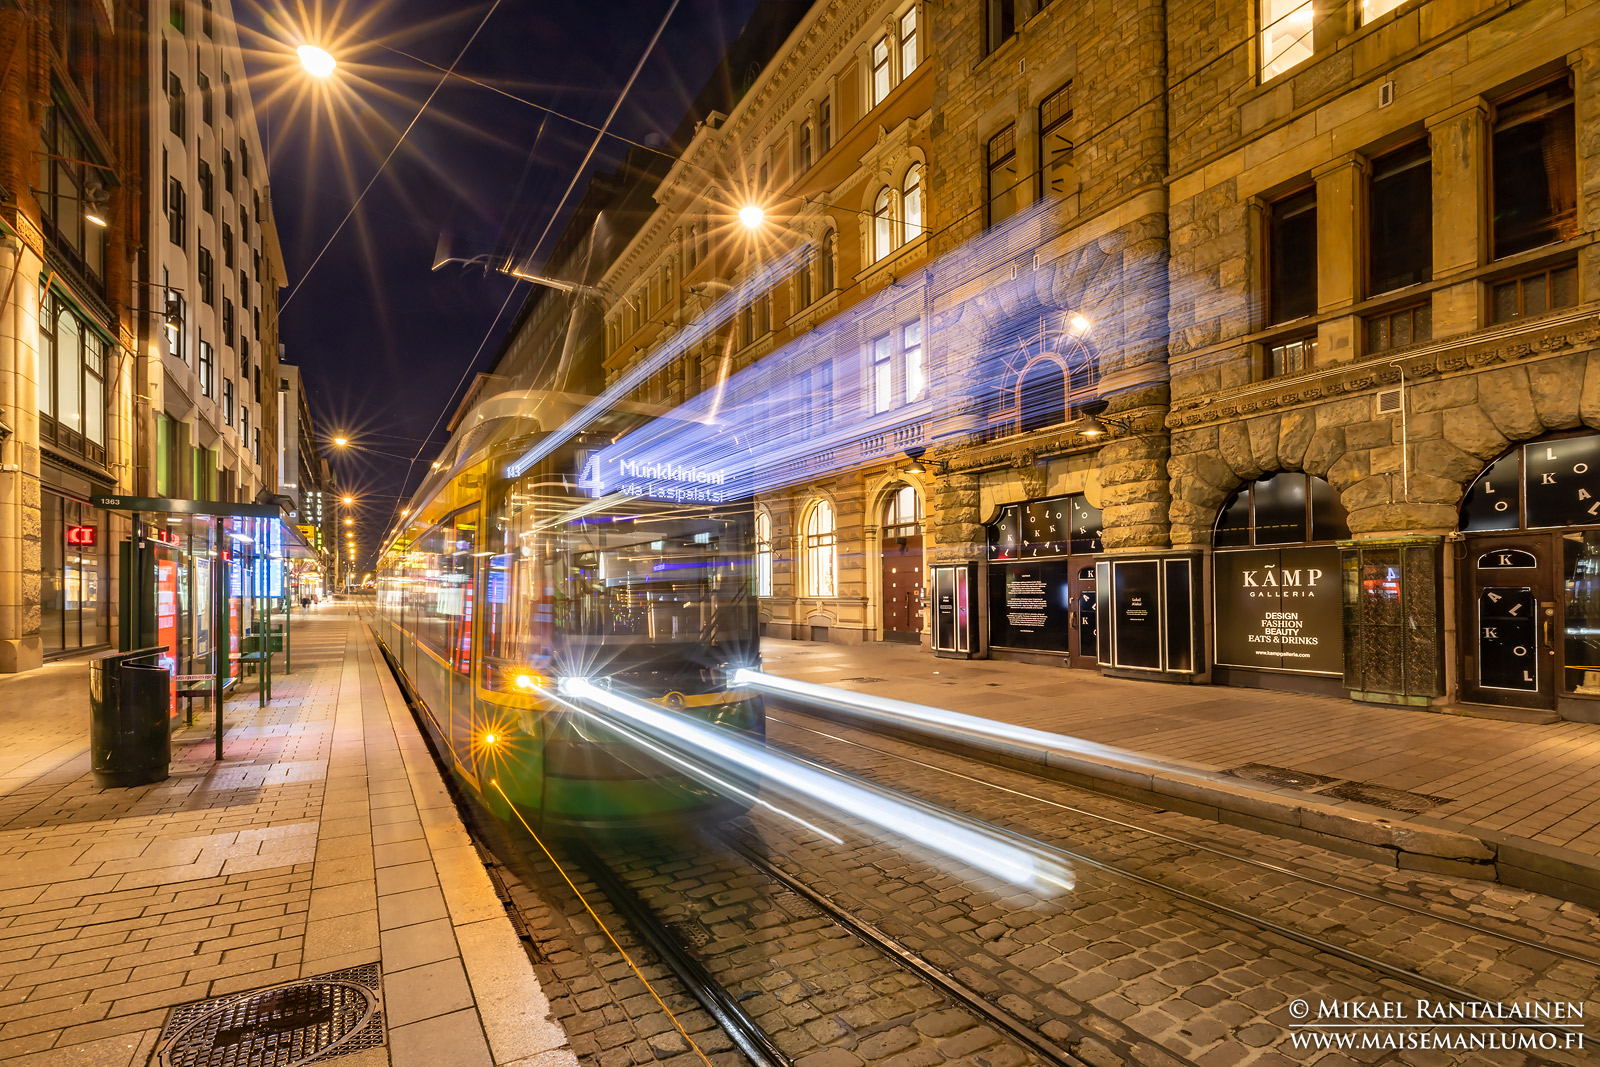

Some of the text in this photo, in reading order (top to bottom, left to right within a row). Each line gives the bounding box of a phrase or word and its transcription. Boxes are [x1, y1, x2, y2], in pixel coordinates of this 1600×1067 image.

[1546, 448, 1557, 460] L
[1573, 463, 1588, 474] O
[578, 454, 725, 499] 4 Munkkiniemi
[1540, 472, 1557, 485] K
[622, 483, 724, 502] via Lasipalatsi
[1485, 481, 1495, 494] L
[1578, 488, 1592, 501] A
[1494, 501, 1508, 511] O
[1587, 501, 1600, 516] L
[1498, 554, 1513, 565] K
[1487, 592, 1502, 603] A
[1265, 612, 1298, 620] DESIGN
[1508, 603, 1522, 617] L
[1261, 620, 1303, 628] FASHION
[1265, 628, 1299, 636] BEAUTY
[1483, 627, 1498, 639] K
[1248, 635, 1272, 643] EATS
[1282, 636, 1318, 645] DRINKS
[1513, 646, 1527, 657] O
[1523, 670, 1533, 682] L
